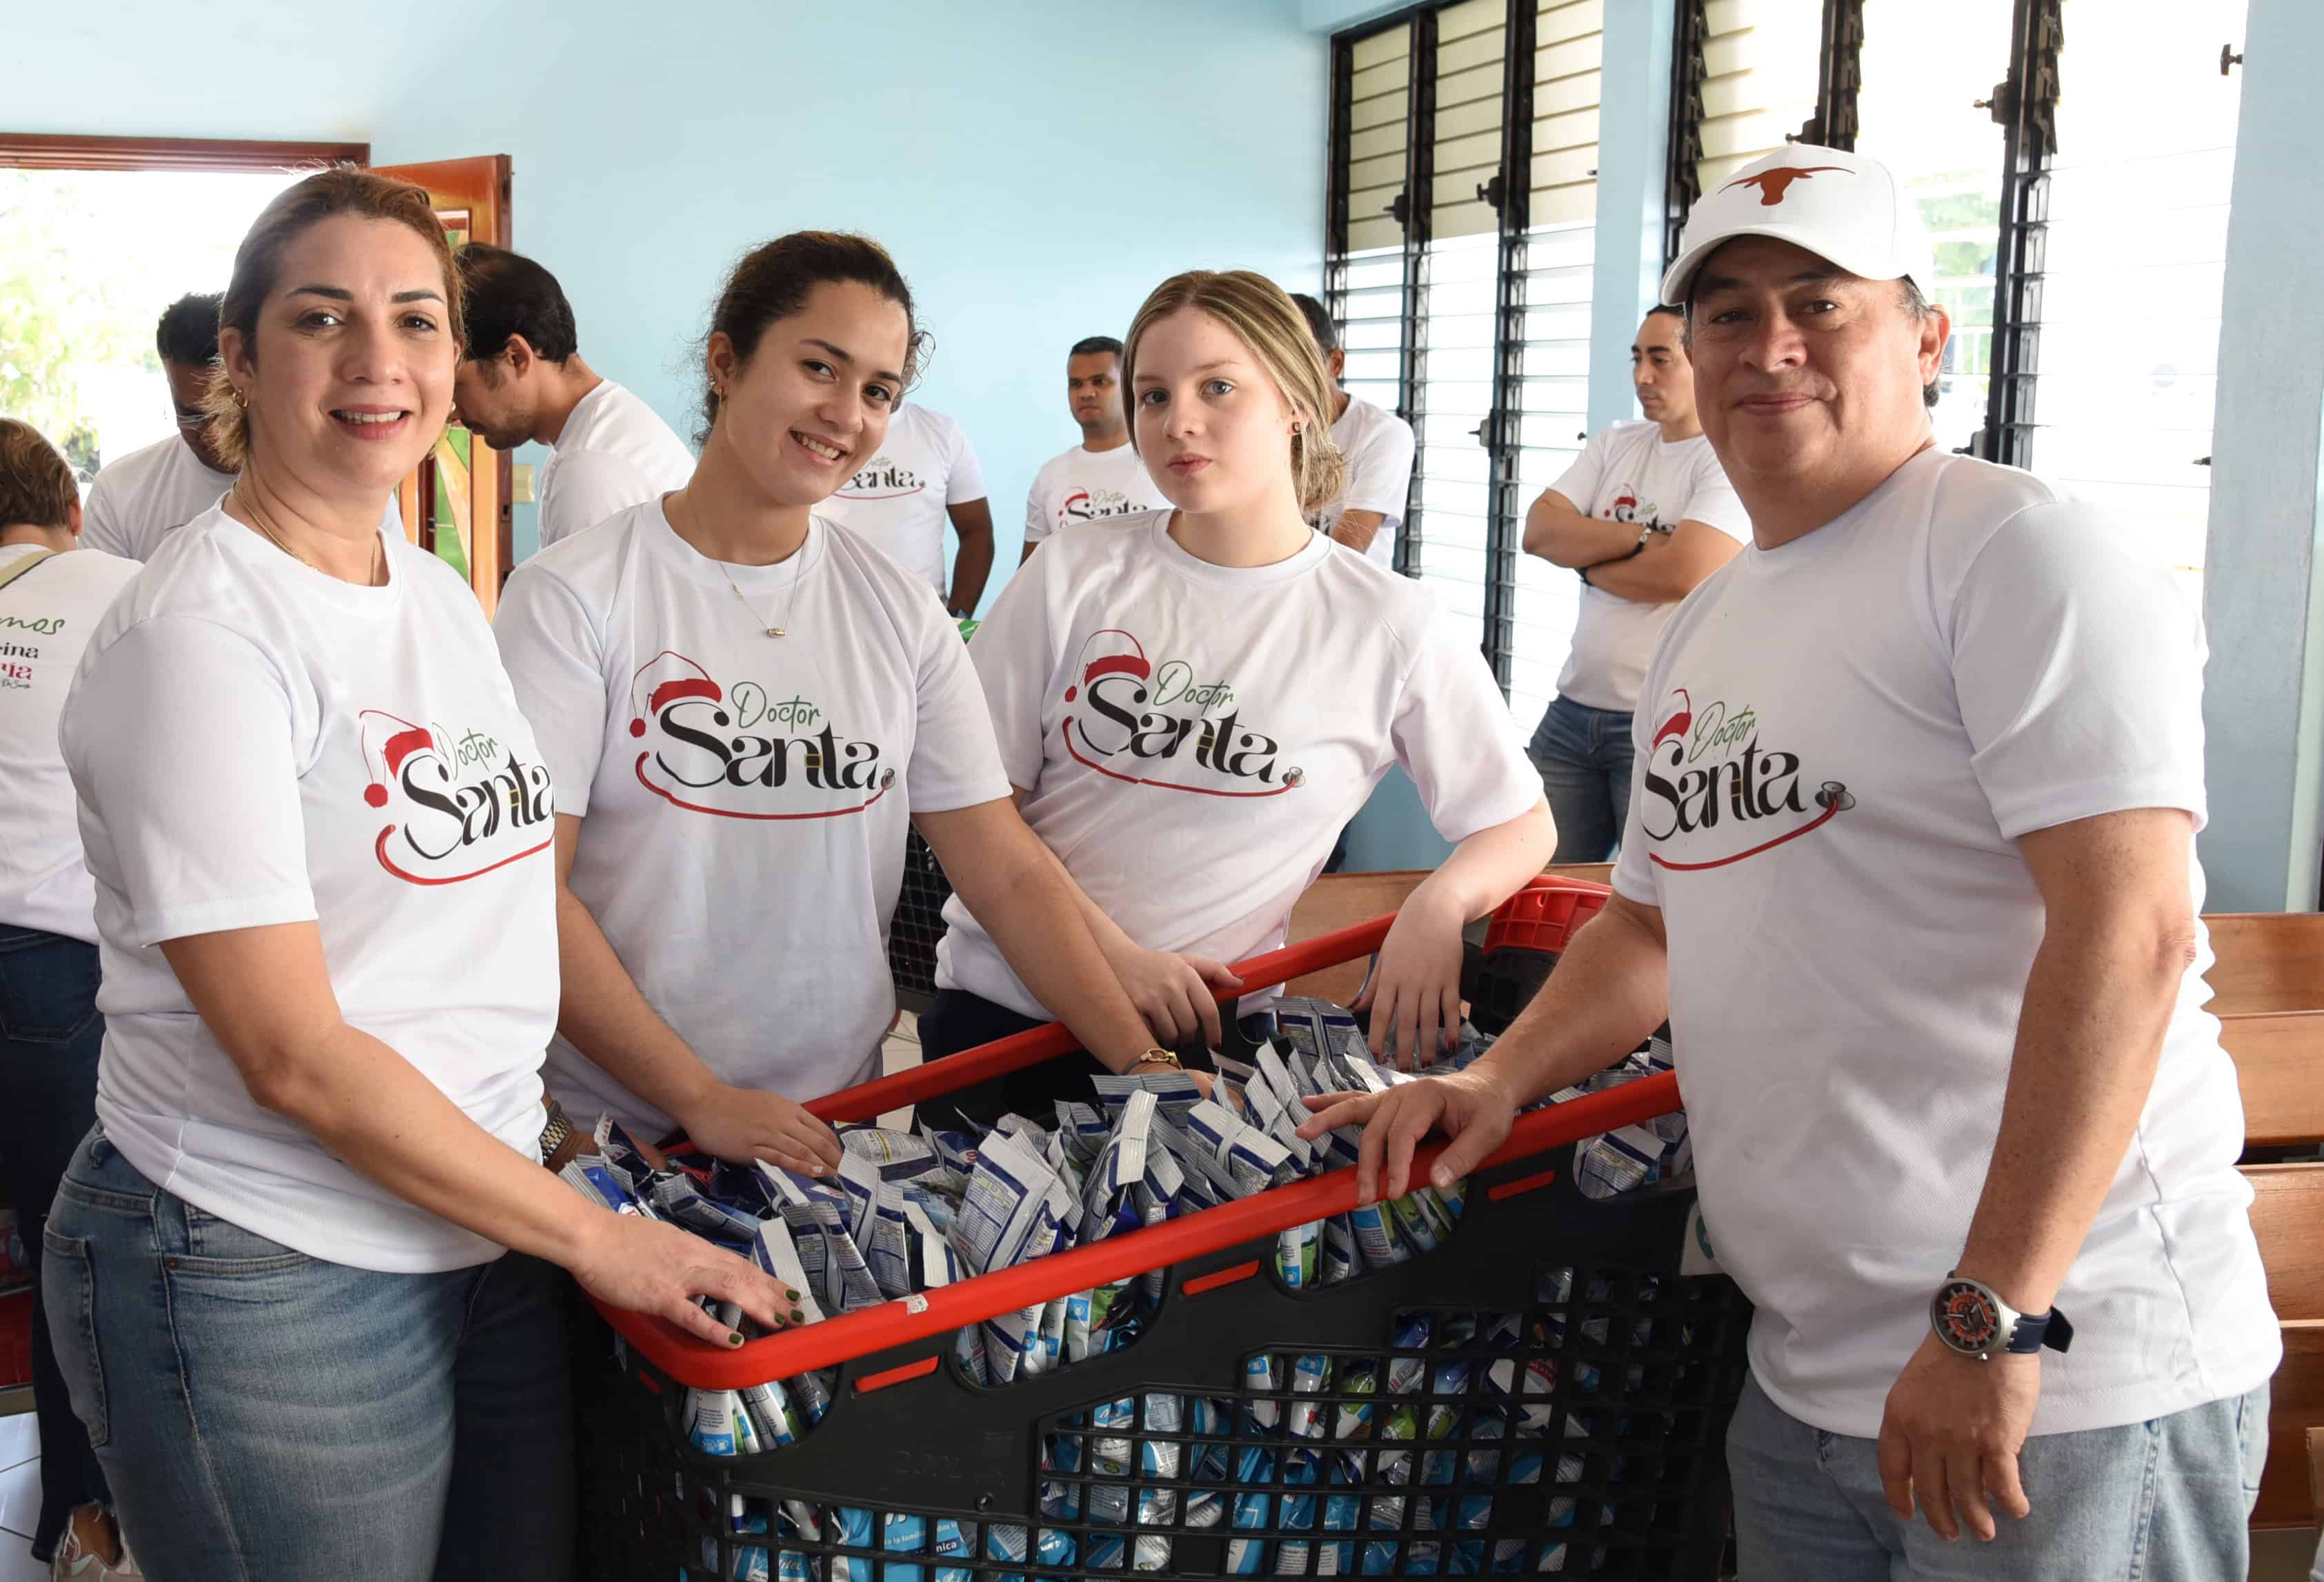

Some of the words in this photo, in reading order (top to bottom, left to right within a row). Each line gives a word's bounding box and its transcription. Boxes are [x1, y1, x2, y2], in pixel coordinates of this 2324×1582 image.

[0, 641, 39, 659] ina
[731, 681, 821, 734] Doctor
[1153, 660, 1235, 717] Doctor
[431, 722, 497, 781] Doctor
[656, 701, 880, 790] Santa
[1078, 677, 1278, 783] Santa
[1688, 701, 1756, 763] Doctor
[1640, 728, 1808, 841] Santa
